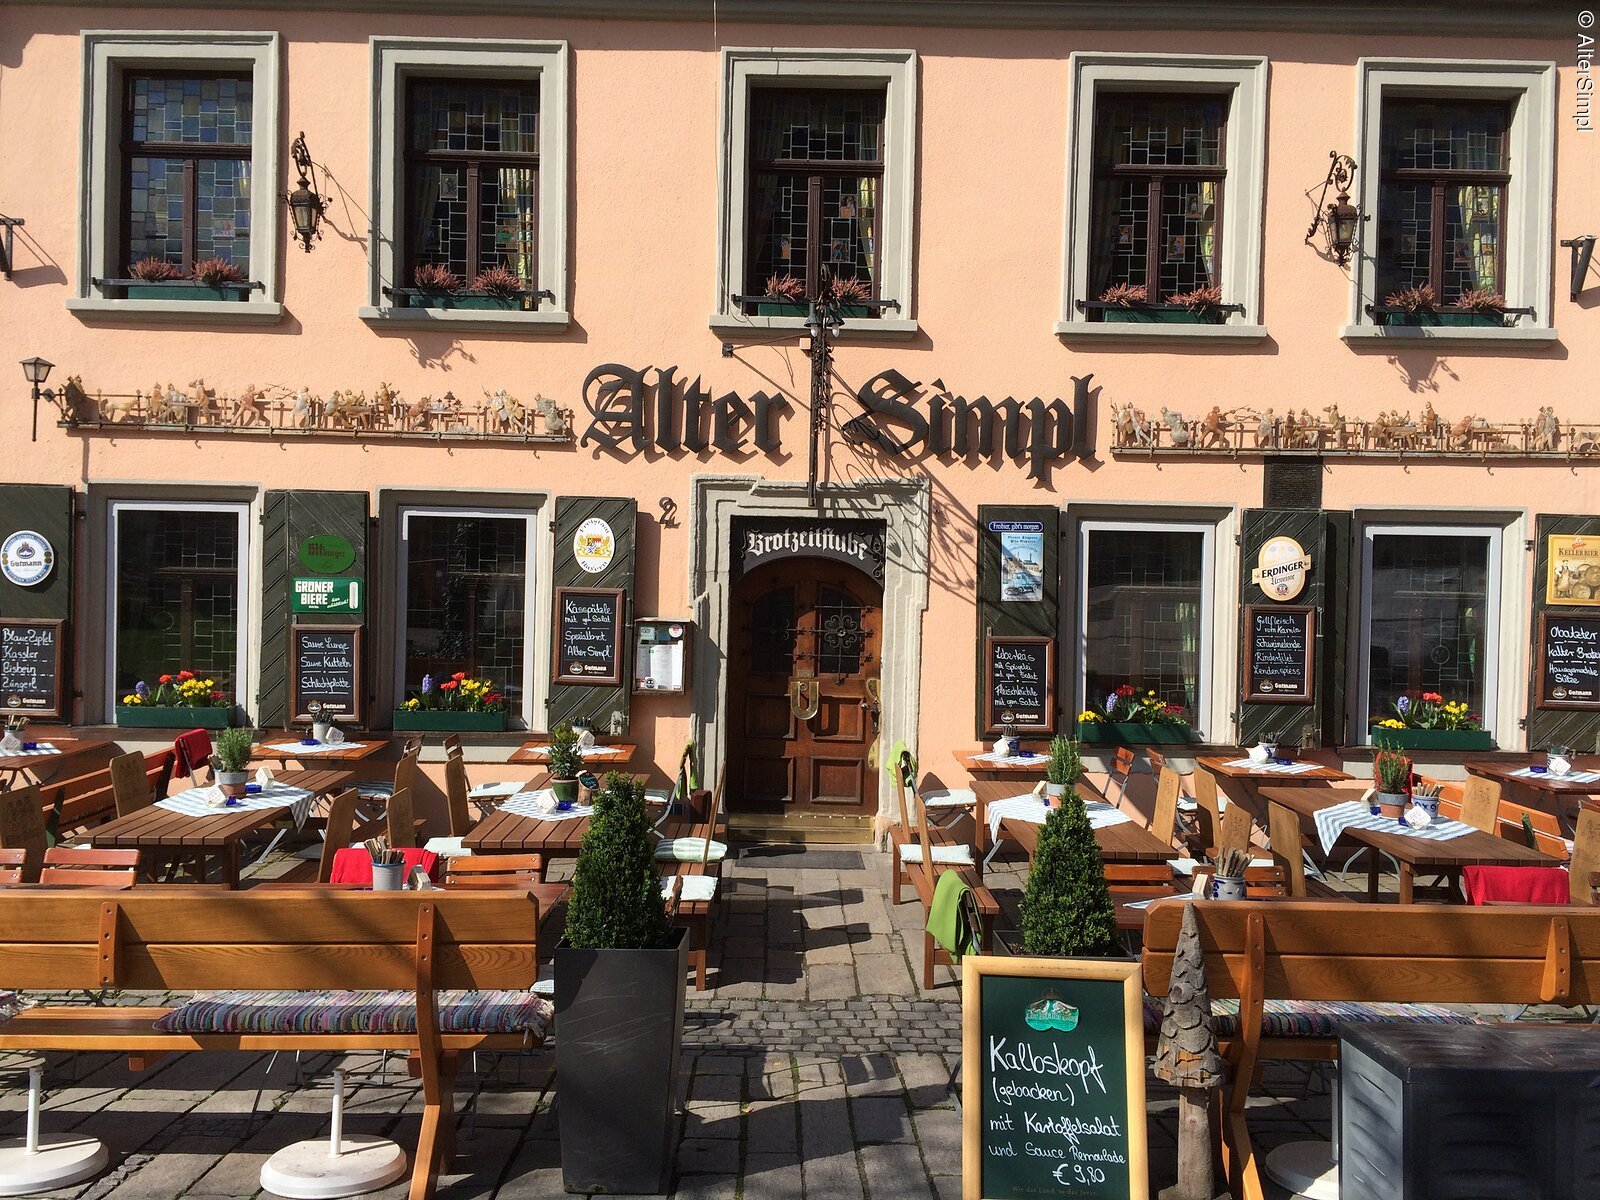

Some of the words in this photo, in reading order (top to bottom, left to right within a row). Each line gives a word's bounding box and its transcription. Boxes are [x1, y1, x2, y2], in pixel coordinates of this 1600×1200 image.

[580, 362, 792, 458] Alter
[845, 367, 1096, 482] Simpl
[1261, 561, 1304, 578] ERDINGER
[301, 593, 328, 605] BIERE
[2, 646, 39, 659] Kassler
[989, 1034, 1107, 1095] Kalbskopf
[992, 1076, 1075, 1107] (gebacken)
[989, 1112, 1015, 1132] mit
[1024, 1111, 1122, 1145] Kartoffelsalat
[988, 1141, 1018, 1157] und
[1025, 1141, 1066, 1159] Sauce
[1069, 1144, 1127, 1165] Remoulade
[1073, 1164, 1106, 1186] 9,80
